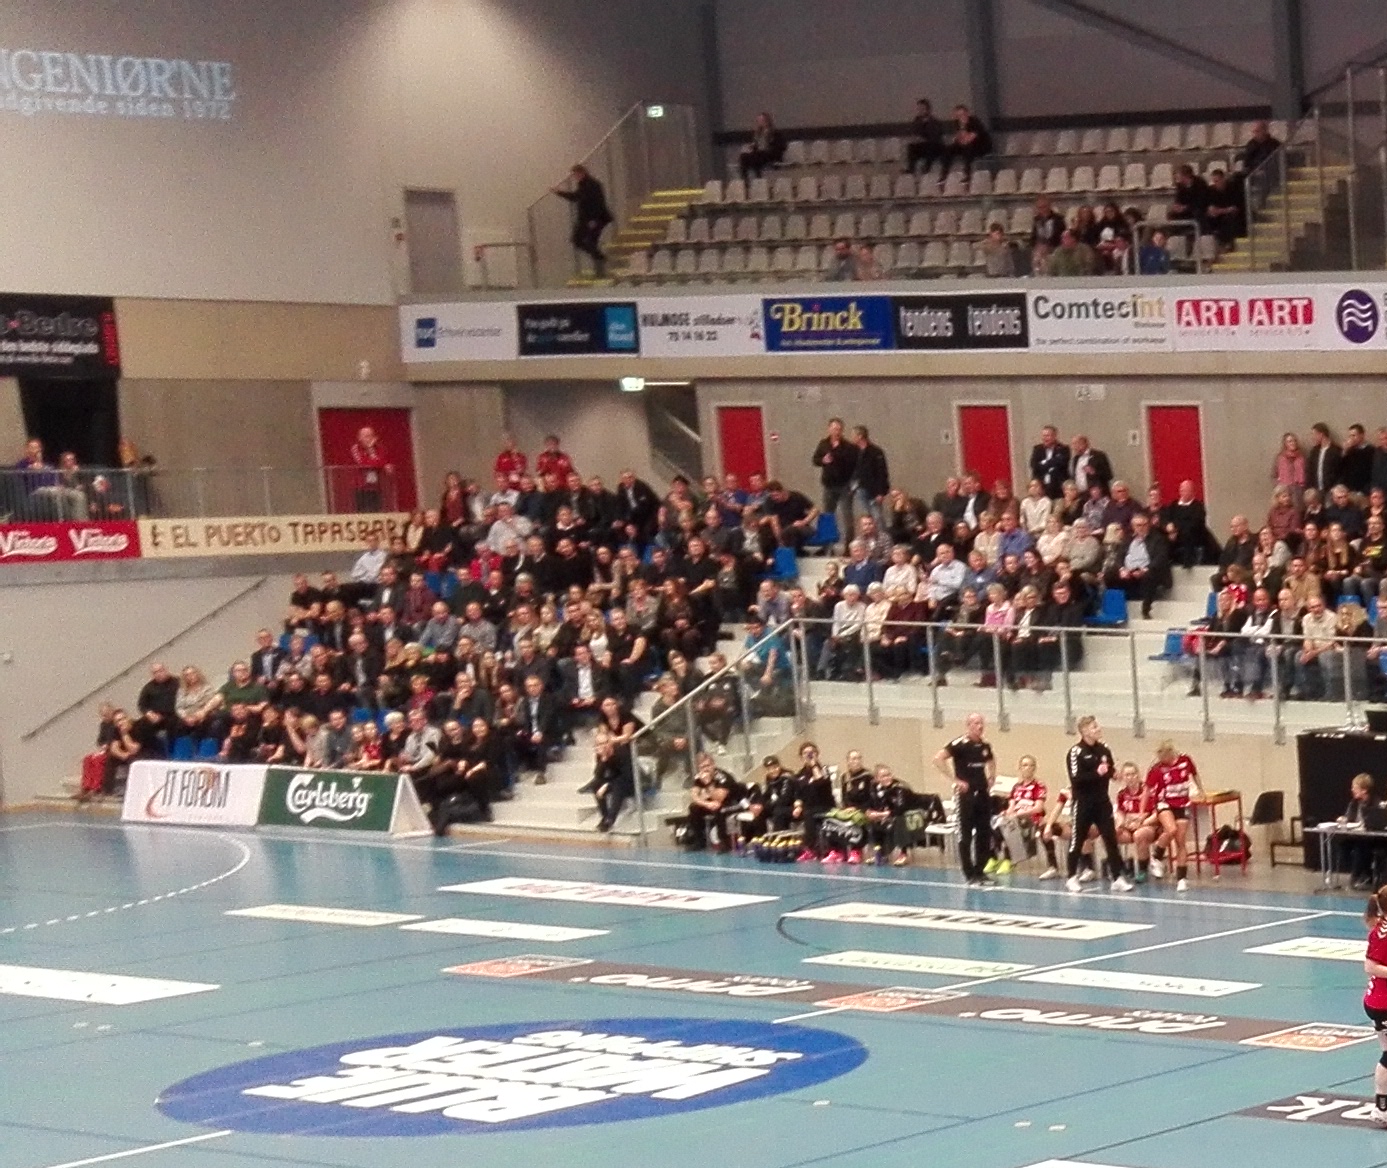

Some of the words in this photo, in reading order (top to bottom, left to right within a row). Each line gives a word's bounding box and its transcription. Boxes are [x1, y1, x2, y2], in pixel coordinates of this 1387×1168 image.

[770, 301, 864, 331] Brinck
[1178, 299, 1238, 327] ART
[1250, 298, 1311, 326] ART
[172, 526, 197, 548] EL
[205, 522, 281, 547] PUERTO
[286, 774, 372, 822] Carlsberg
